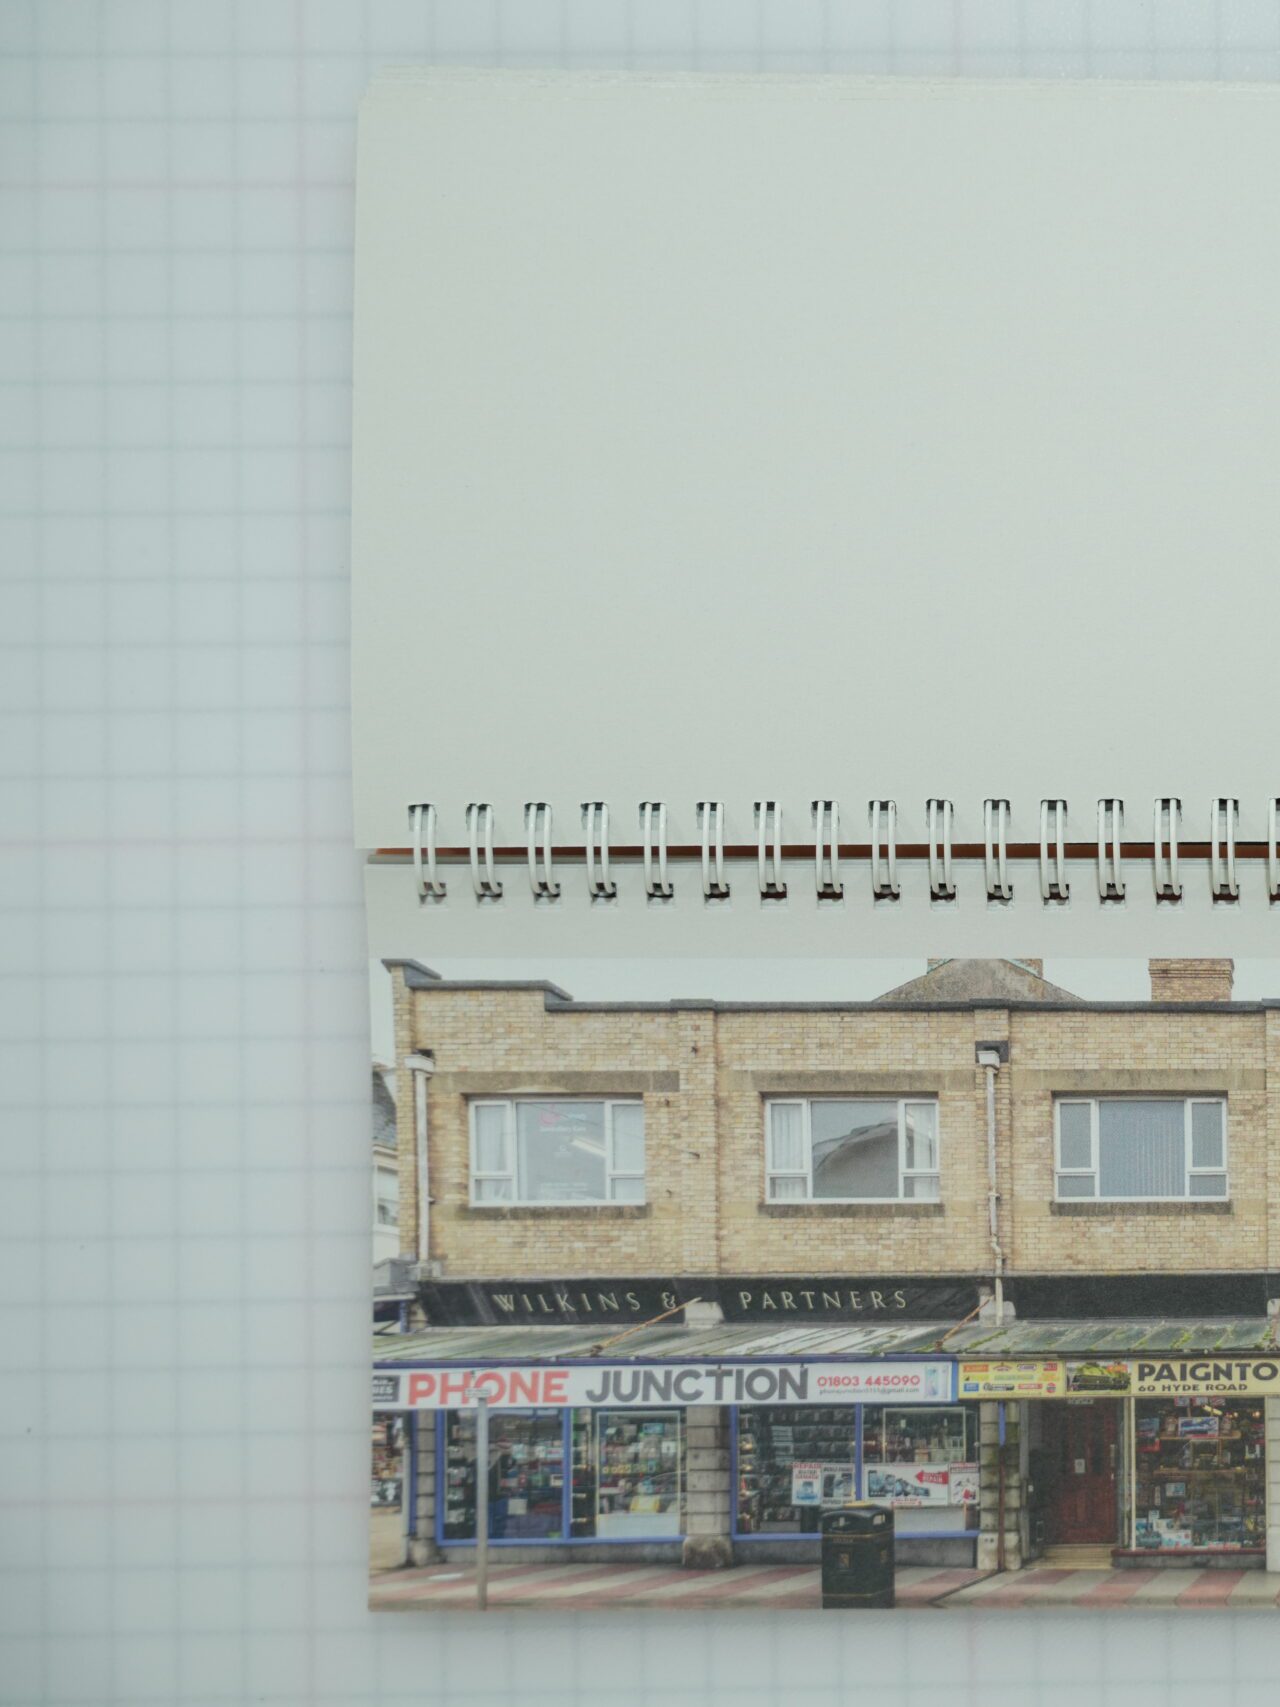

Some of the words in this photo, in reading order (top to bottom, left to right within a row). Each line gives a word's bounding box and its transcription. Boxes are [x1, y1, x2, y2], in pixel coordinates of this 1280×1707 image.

[493, 1291, 641, 1312] WILKINS
[661, 1291, 676, 1311] &
[739, 1290, 907, 1310] PARTNERS
[408, 1370, 569, 1405] PHONE
[586, 1367, 808, 1402] JUNCTION
[817, 1375, 860, 1387] 01803
[865, 1375, 921, 1386] 445090
[1138, 1384, 1156, 1392] 60
[1161, 1383, 1200, 1392] HYDE
[1205, 1383, 1248, 1391] ROAD
